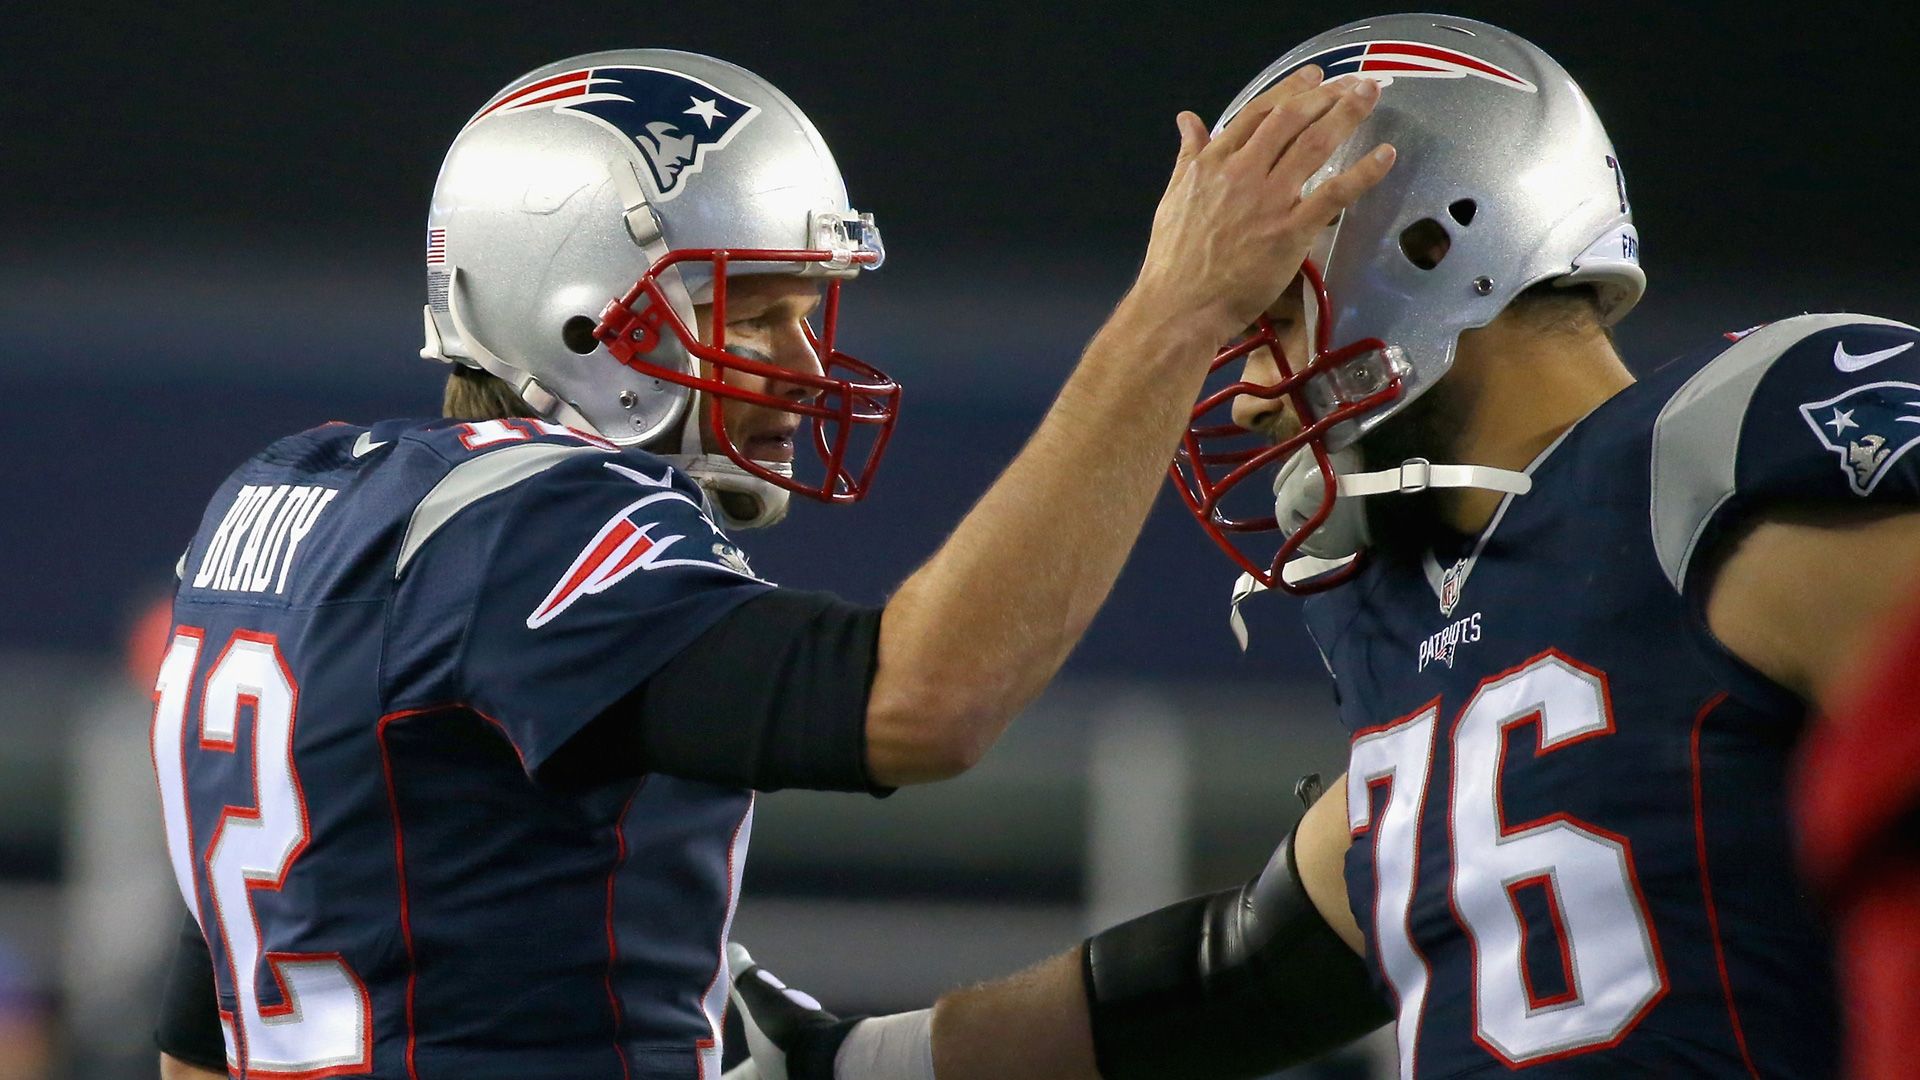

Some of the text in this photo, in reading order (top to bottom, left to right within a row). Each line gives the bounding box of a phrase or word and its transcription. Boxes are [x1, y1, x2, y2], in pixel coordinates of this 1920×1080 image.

[192, 484, 339, 595] BRADY
[1418, 612, 1481, 673] PATRIOTS
[150, 625, 373, 1079] 12
[1346, 646, 1670, 1080] 76
